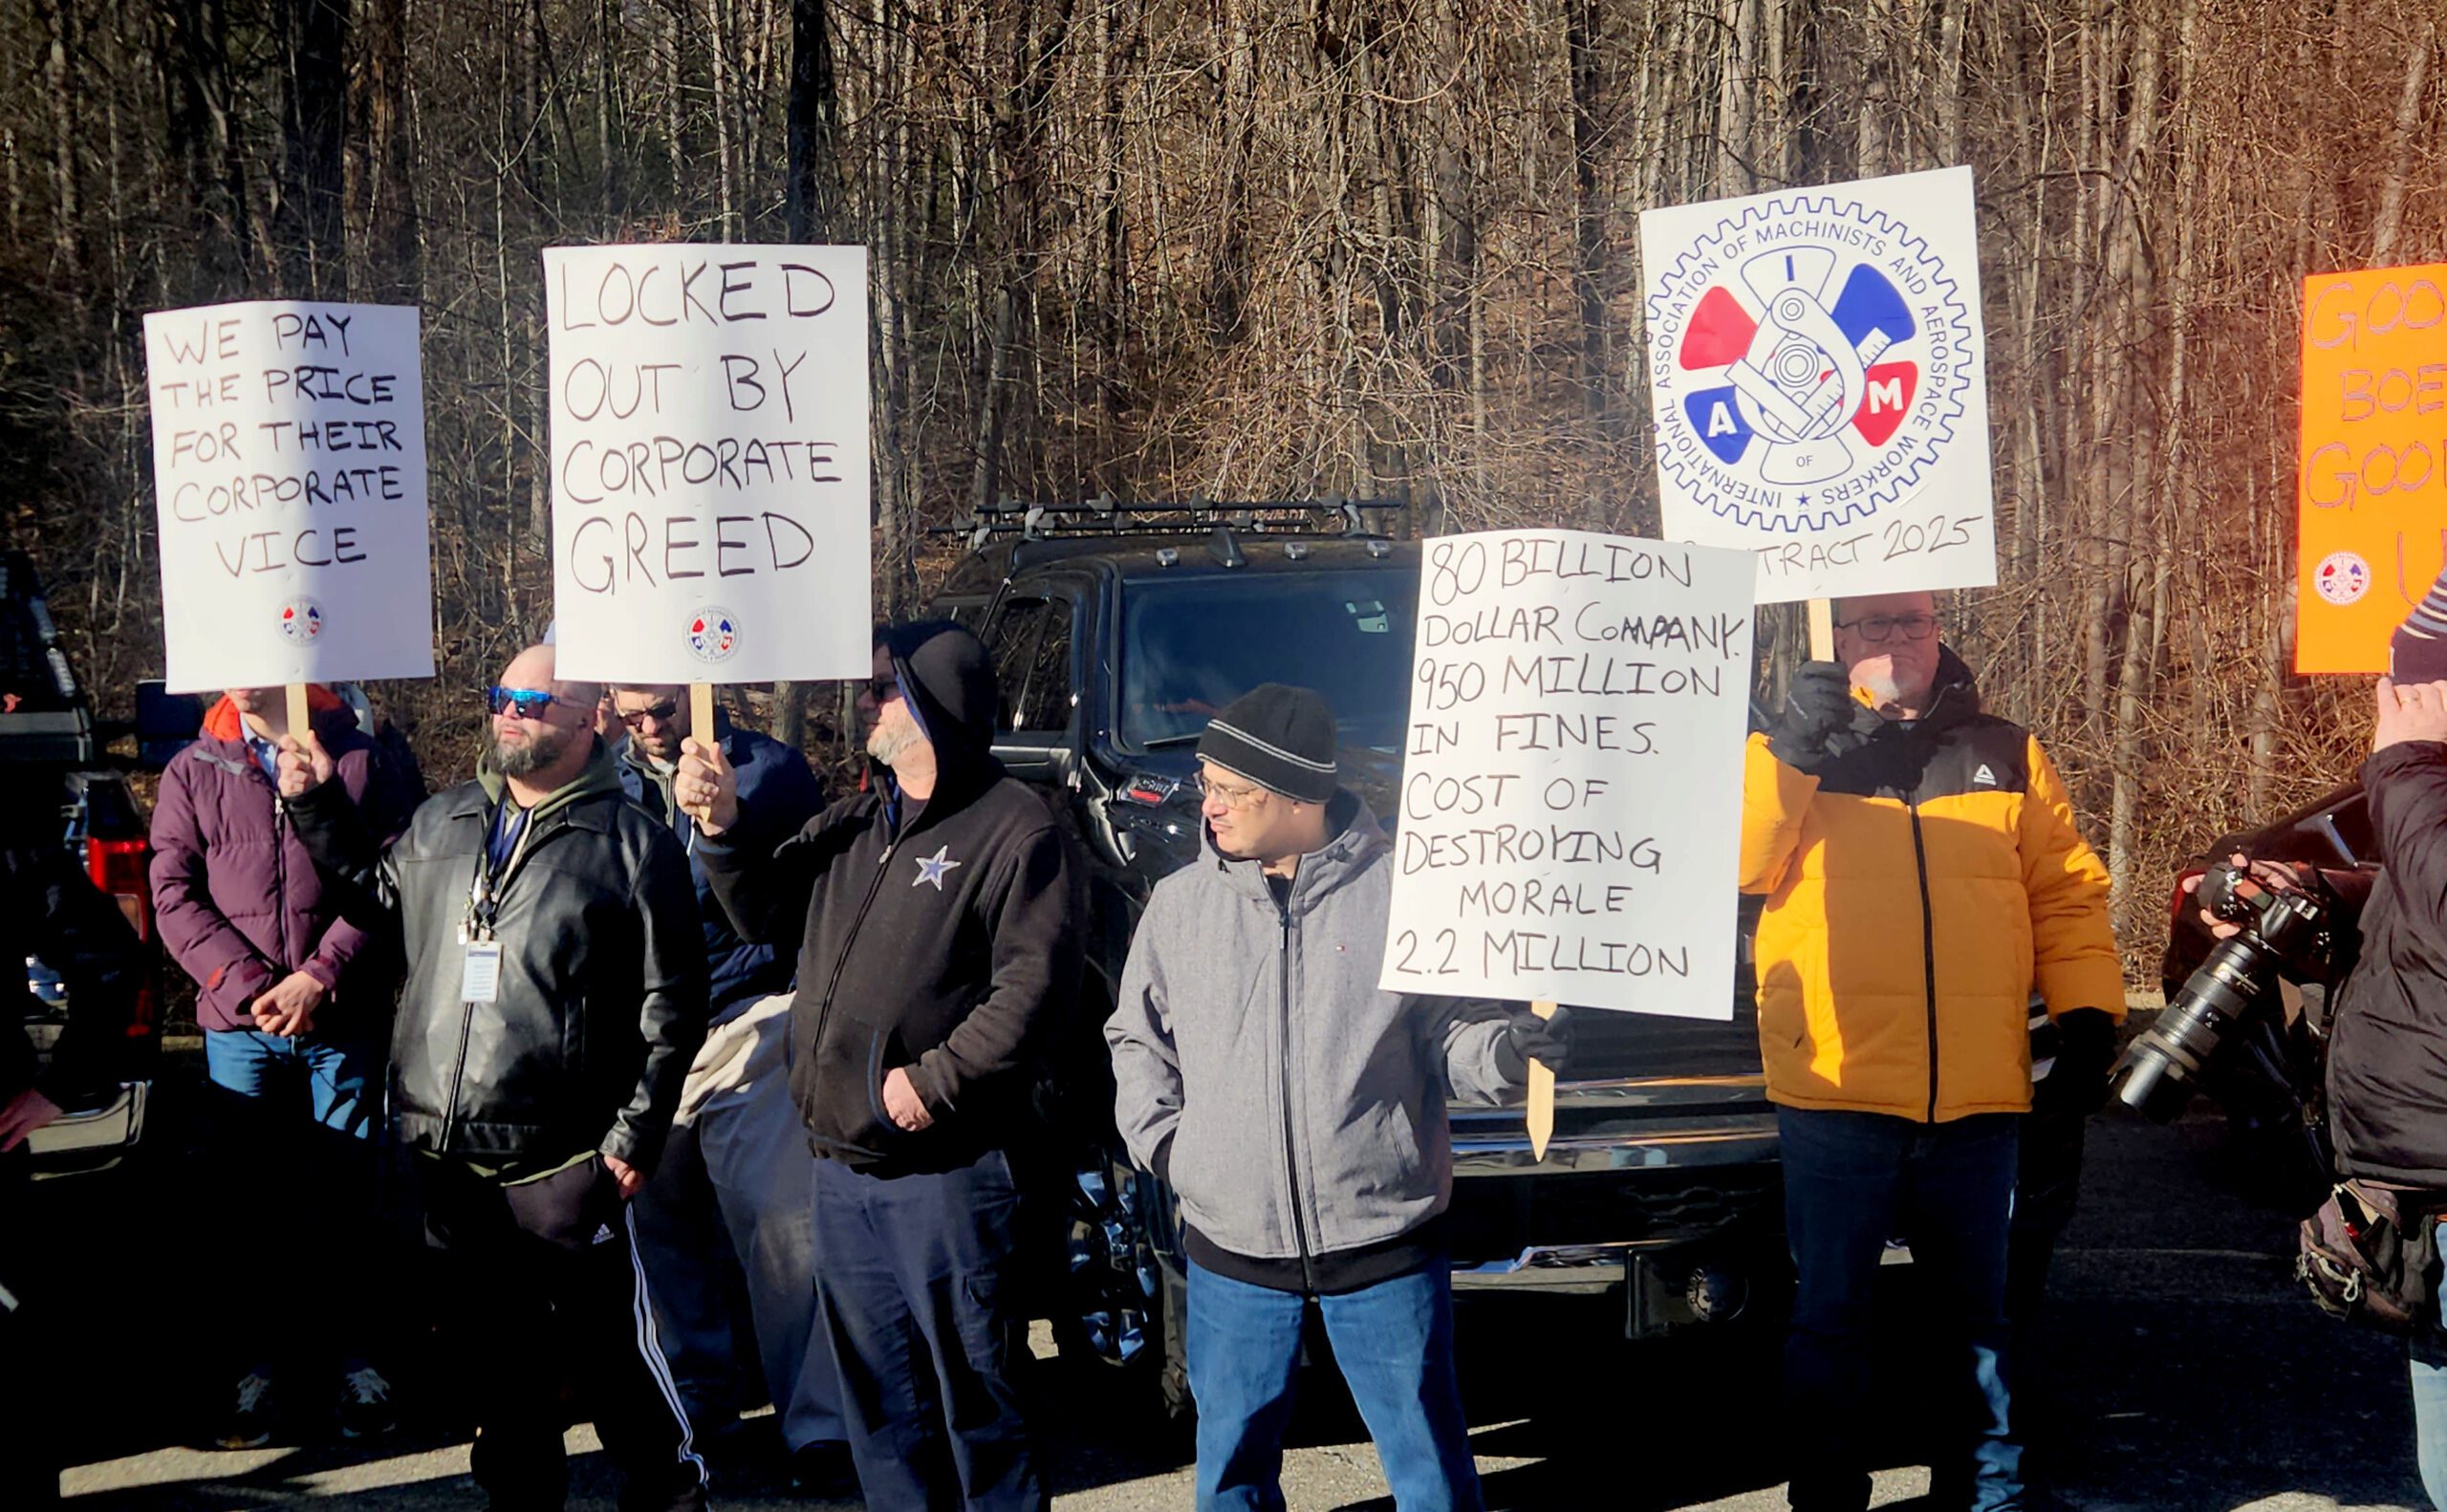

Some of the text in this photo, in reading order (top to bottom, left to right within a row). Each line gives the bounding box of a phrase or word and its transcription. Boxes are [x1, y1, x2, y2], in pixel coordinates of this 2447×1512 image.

[563, 260, 835, 332] LOCKED
[164, 313, 351, 364] WE PAY
[161, 365, 398, 408] THE PRICE
[565, 348, 807, 423] OUT BY
[1654, 220, 1949, 509] INTERNATIONAL ASSOCIATION OF MACHINISTS AND AEROSPACE WORKERS
[1706, 400, 1738, 437] A
[1868, 378, 1903, 414] M
[172, 421, 403, 468] FOR THEIR
[1796, 455, 1813, 468] OF
[172, 464, 404, 523] CORPORATE
[563, 436, 843, 505] CORPORATE
[2306, 439, 2447, 511] GOO
[216, 528, 367, 577] VICE
[572, 511, 814, 596] GREED
[1747, 514, 1983, 577] TRACT 2025
[1431, 539, 1691, 606] 80 BILLION
[1424, 604, 1563, 647] DOLLAR
[1418, 653, 1721, 711] 950 MILLION
[1411, 713, 1660, 756] IN FINES.
[1407, 772, 1609, 821] COST OF
[1403, 824, 1662, 875] DESTROYING
[1460, 879, 1634, 918] MORALE
[1396, 929, 1689, 979] 2.2 MILLION
